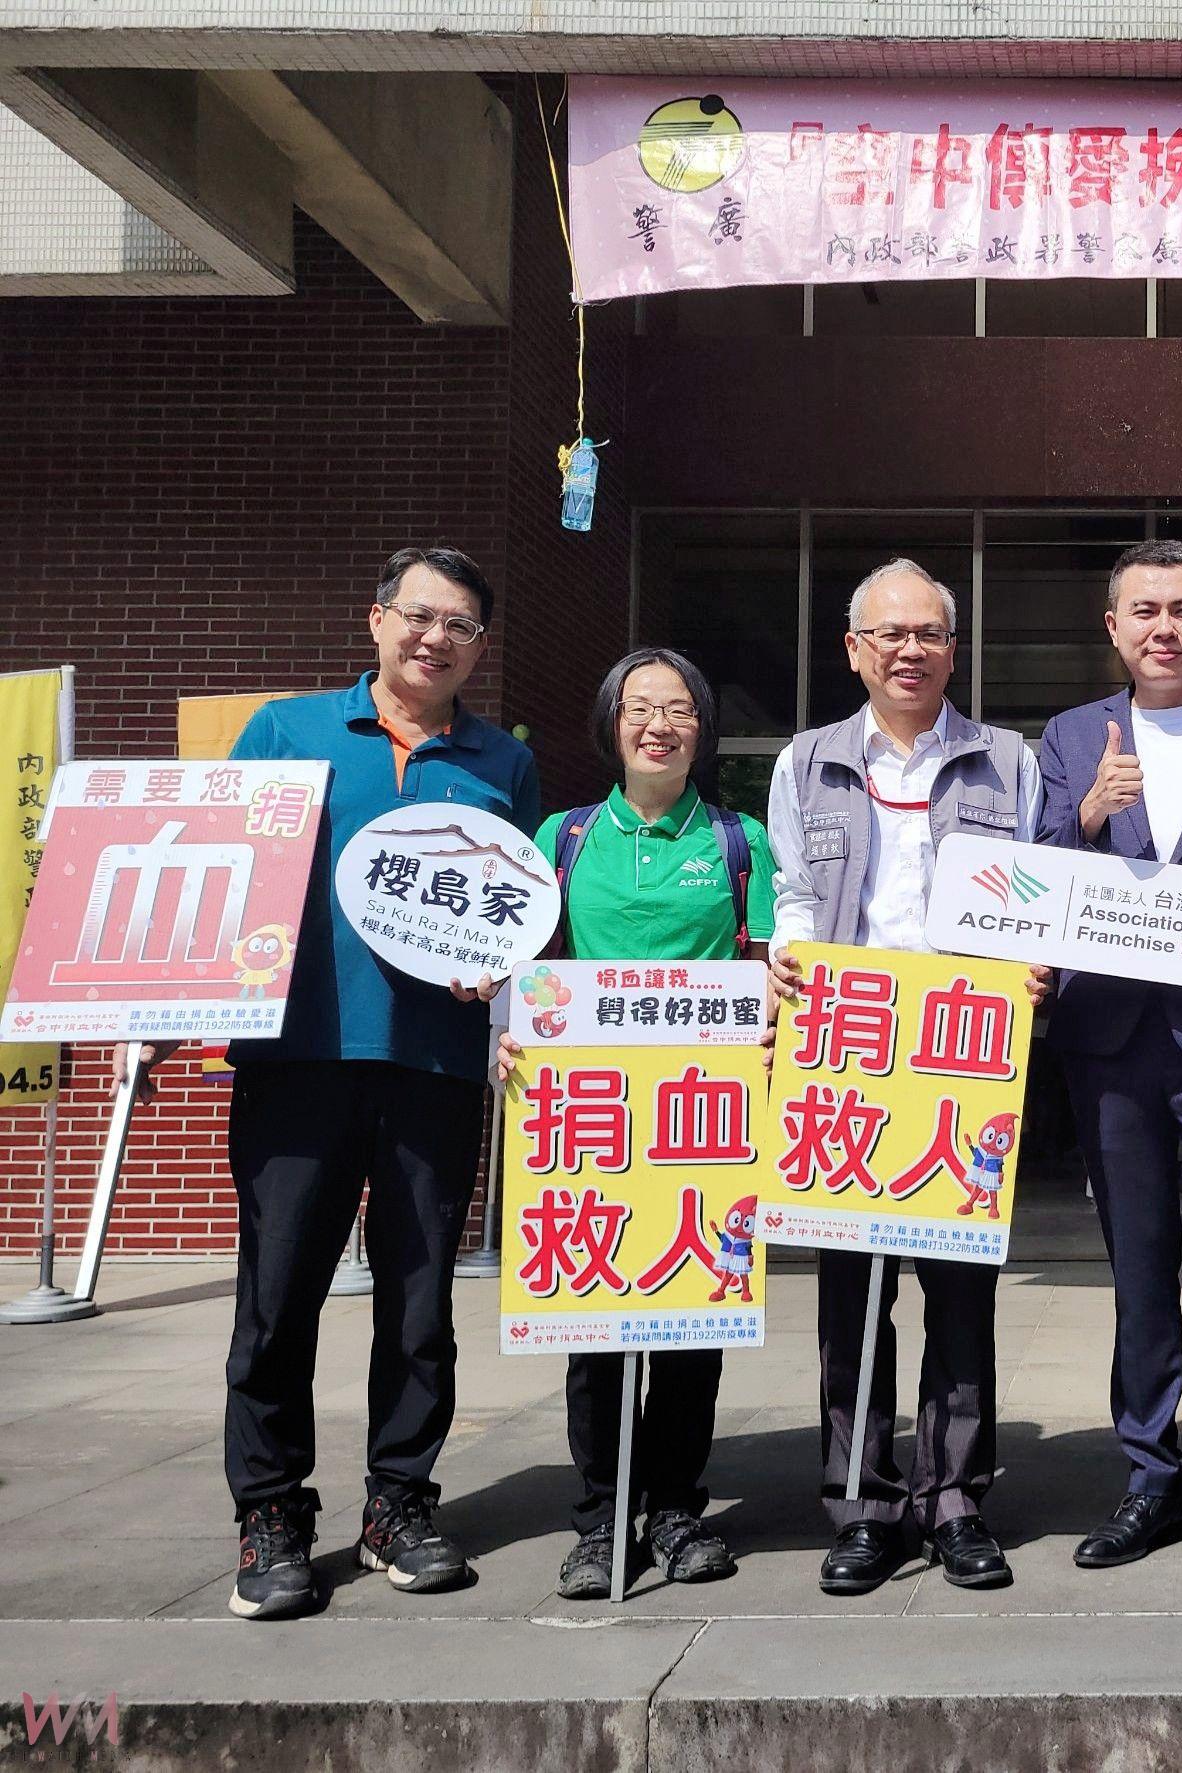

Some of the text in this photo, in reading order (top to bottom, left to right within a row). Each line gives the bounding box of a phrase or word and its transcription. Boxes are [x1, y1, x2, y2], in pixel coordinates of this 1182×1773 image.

[82, 767, 311, 837] 需要您 捐
[364, 849, 531, 927] 櫻島家
[679, 879, 719, 888] ACFPT
[1084, 884, 1147, 907] 社團法人
[359, 916, 508, 970] 櫻島家高品質鮮乳
[366, 899, 513, 950] Sa Ku Ra Zi Ma Ya
[958, 911, 1050, 938] ACFPT
[1077, 926, 1175, 953] Franchise
[596, 996, 761, 1028] 覺得好甜蜜
[794, 965, 1011, 1075] 捐血
[0, 1065, 53, 1094] 4.5
[522, 1065, 753, 1170] 捐血
[778, 1085, 989, 1202] 救人
[519, 1188, 744, 1294] 救人
